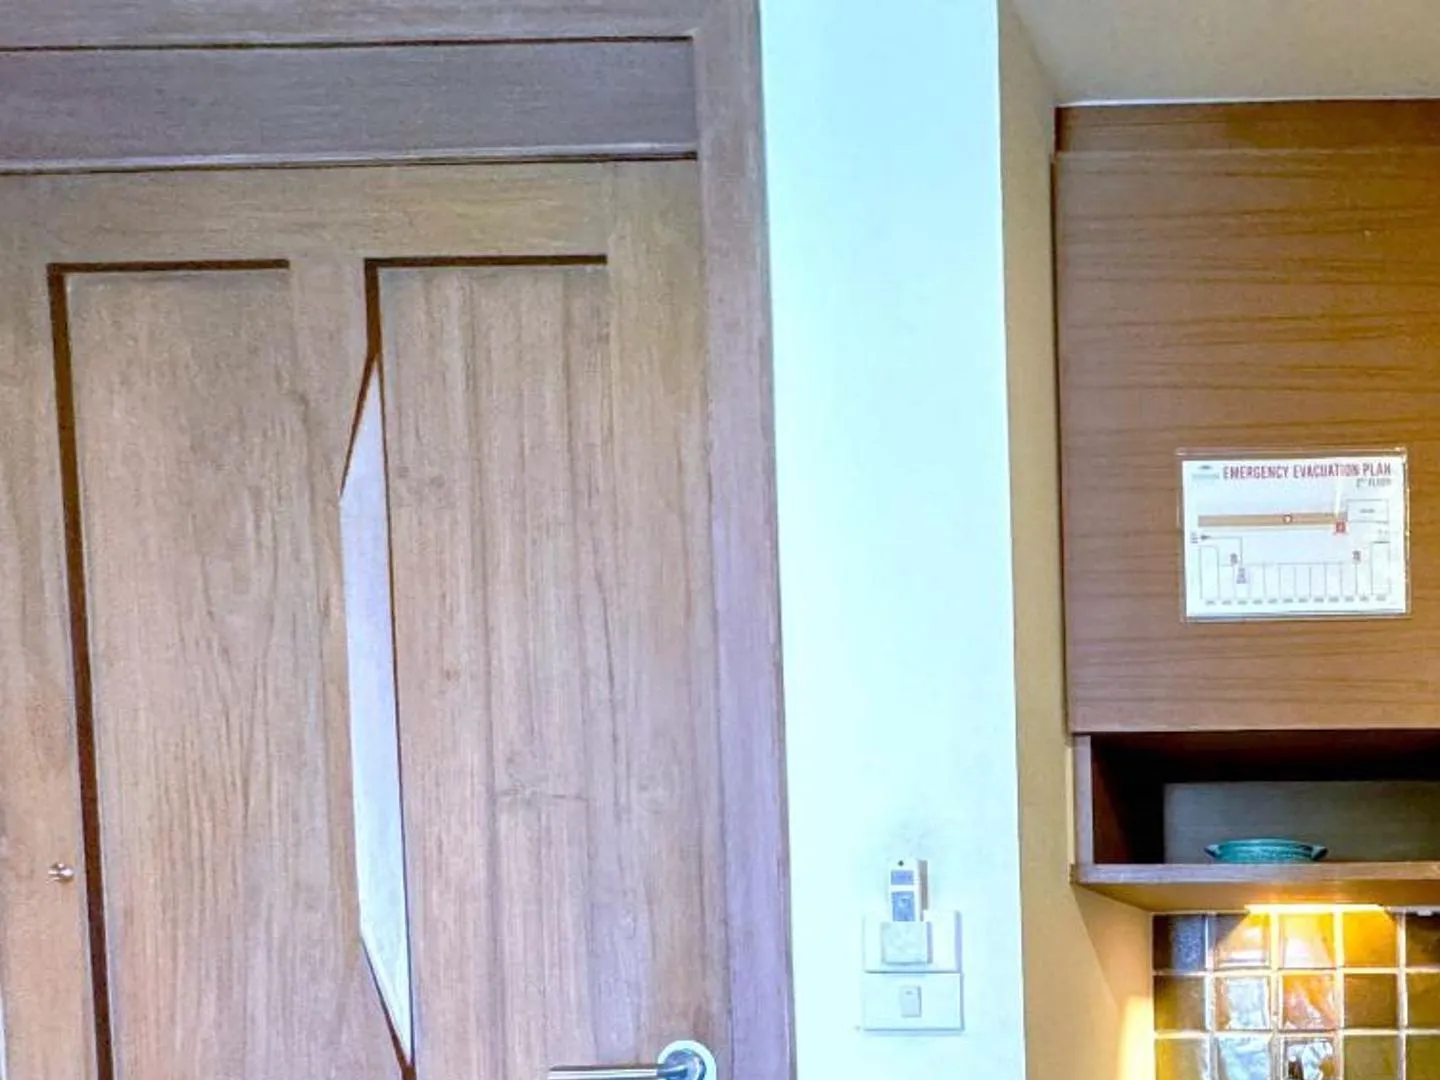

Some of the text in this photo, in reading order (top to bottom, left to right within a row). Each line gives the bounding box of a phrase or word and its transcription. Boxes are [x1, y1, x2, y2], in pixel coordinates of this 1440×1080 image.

[1223, 465, 1289, 479] EMERGENCY
[1293, 463, 1360, 478] EVACUATION
[1362, 462, 1392, 476] PLAN
